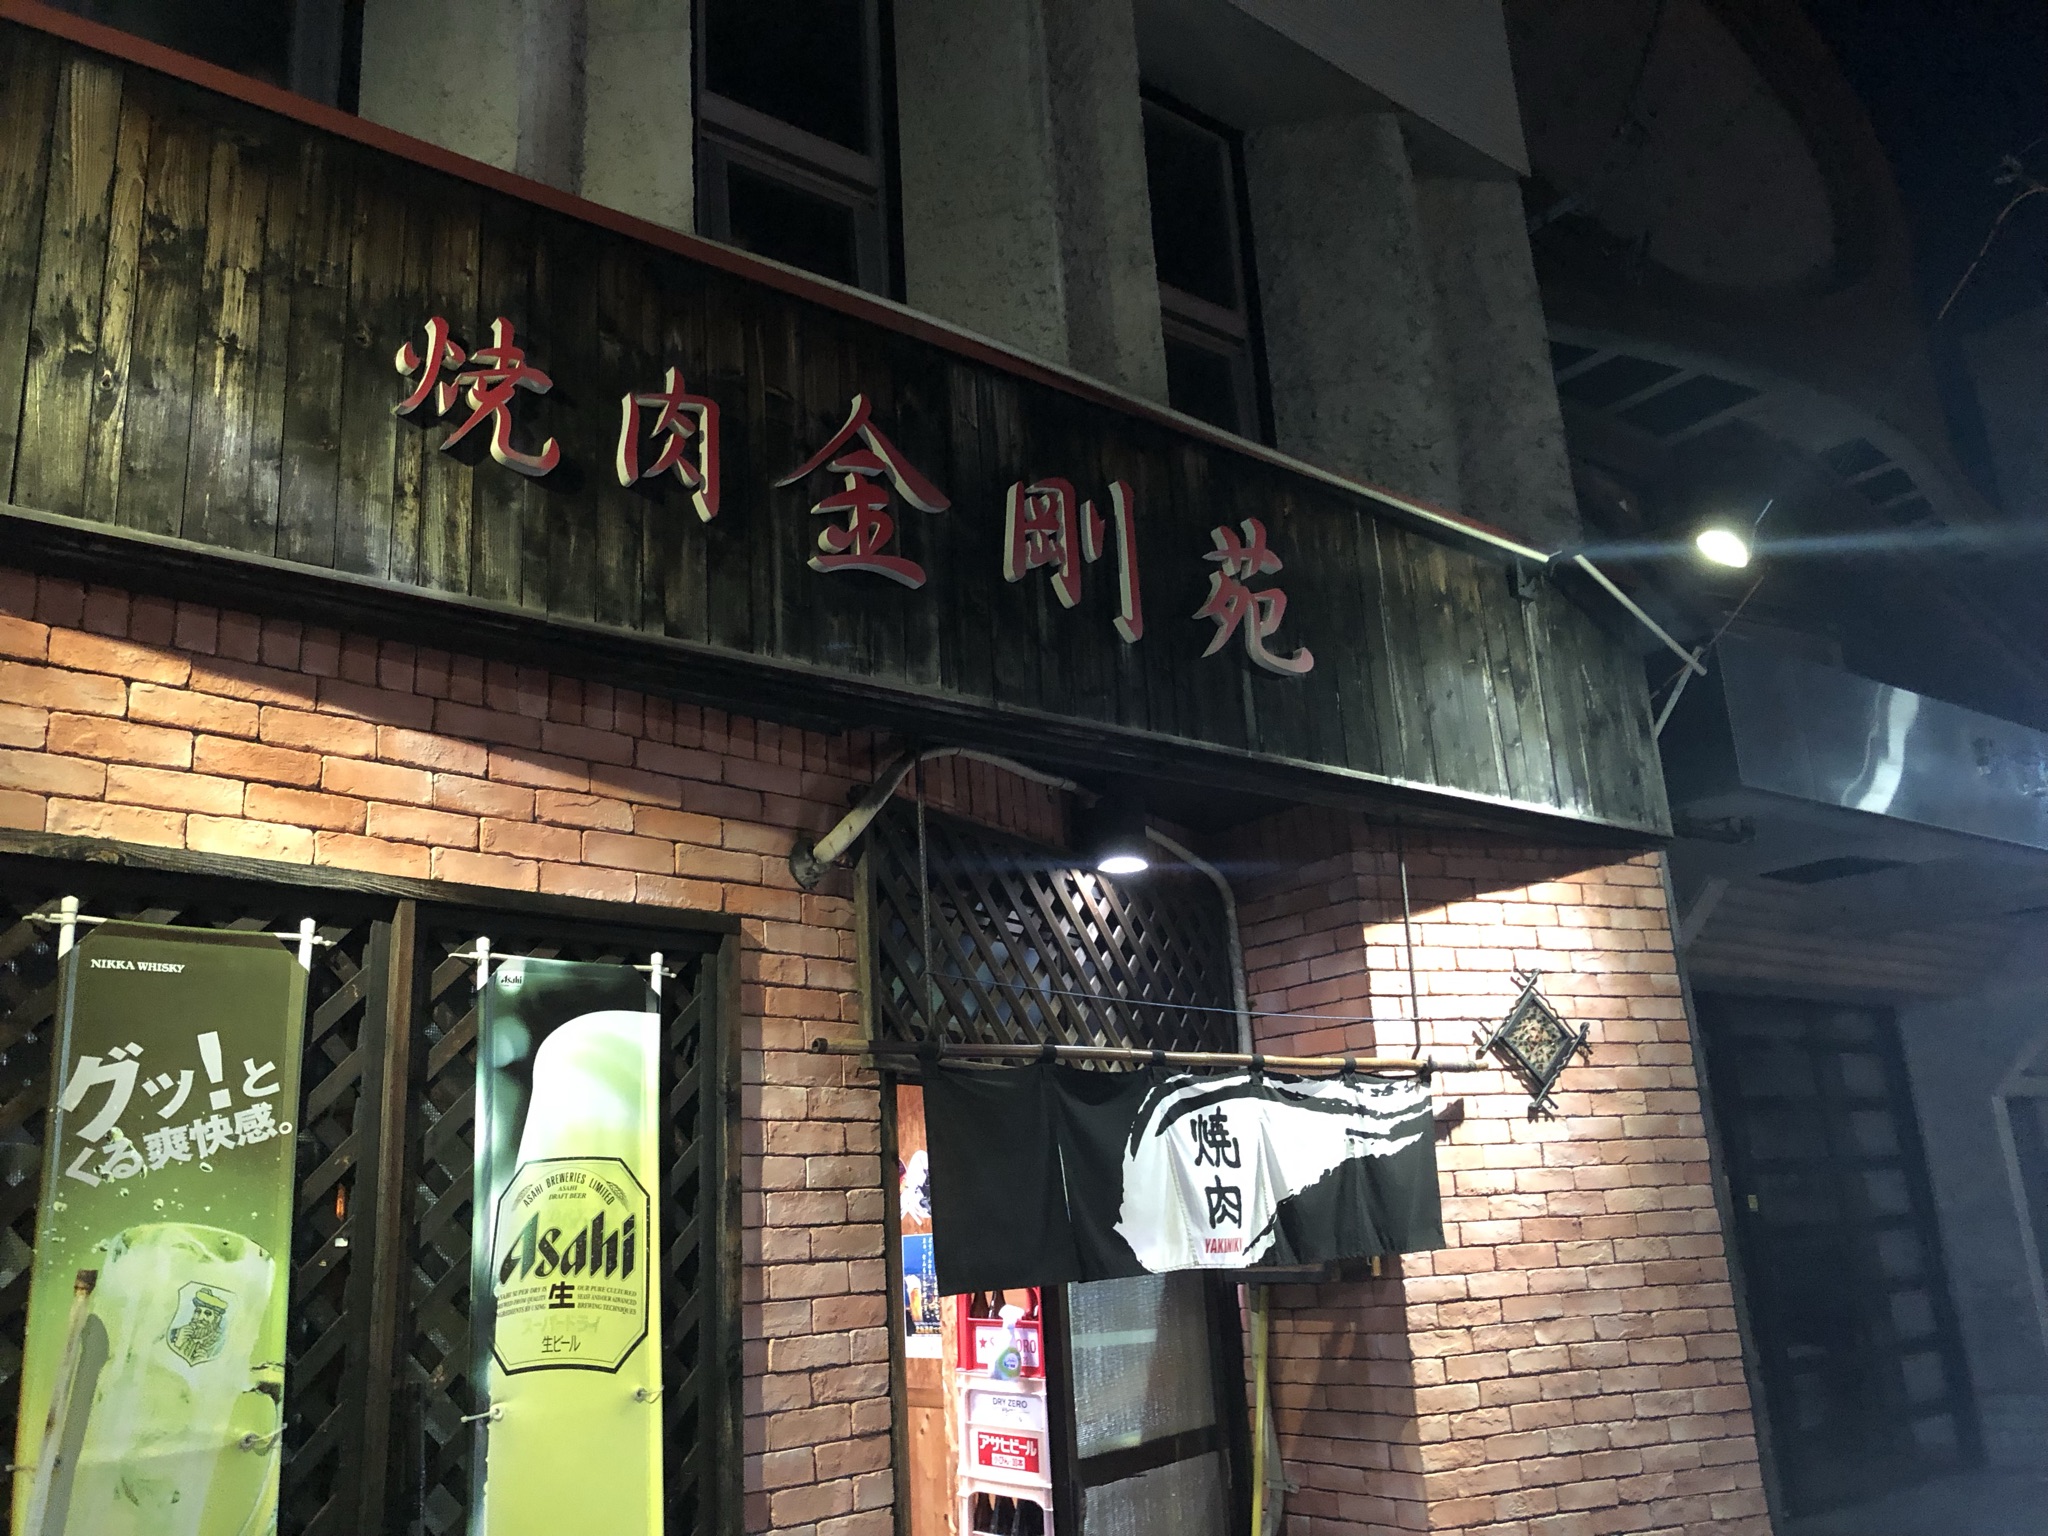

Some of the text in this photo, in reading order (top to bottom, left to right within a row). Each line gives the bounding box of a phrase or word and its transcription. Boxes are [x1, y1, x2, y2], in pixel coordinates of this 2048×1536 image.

[394, 315, 1315, 677] 焼肉金剛苑
[91, 958, 185, 973] NIKKA WHISKY
[501, 975, 522, 984] Asahi
[1190, 1105, 1242, 1230] 焼肉
[523, 1171, 615, 1208] ASAHI BREWERIES LIMITED
[499, 1210, 636, 1287] Asahi
[548, 1281, 575, 1309] 生
[541, 1335, 581, 1353] 生ビール
[993, 1397, 1028, 1409] DRY ZERO
[979, 1434, 1037, 1457] アサヒビール
